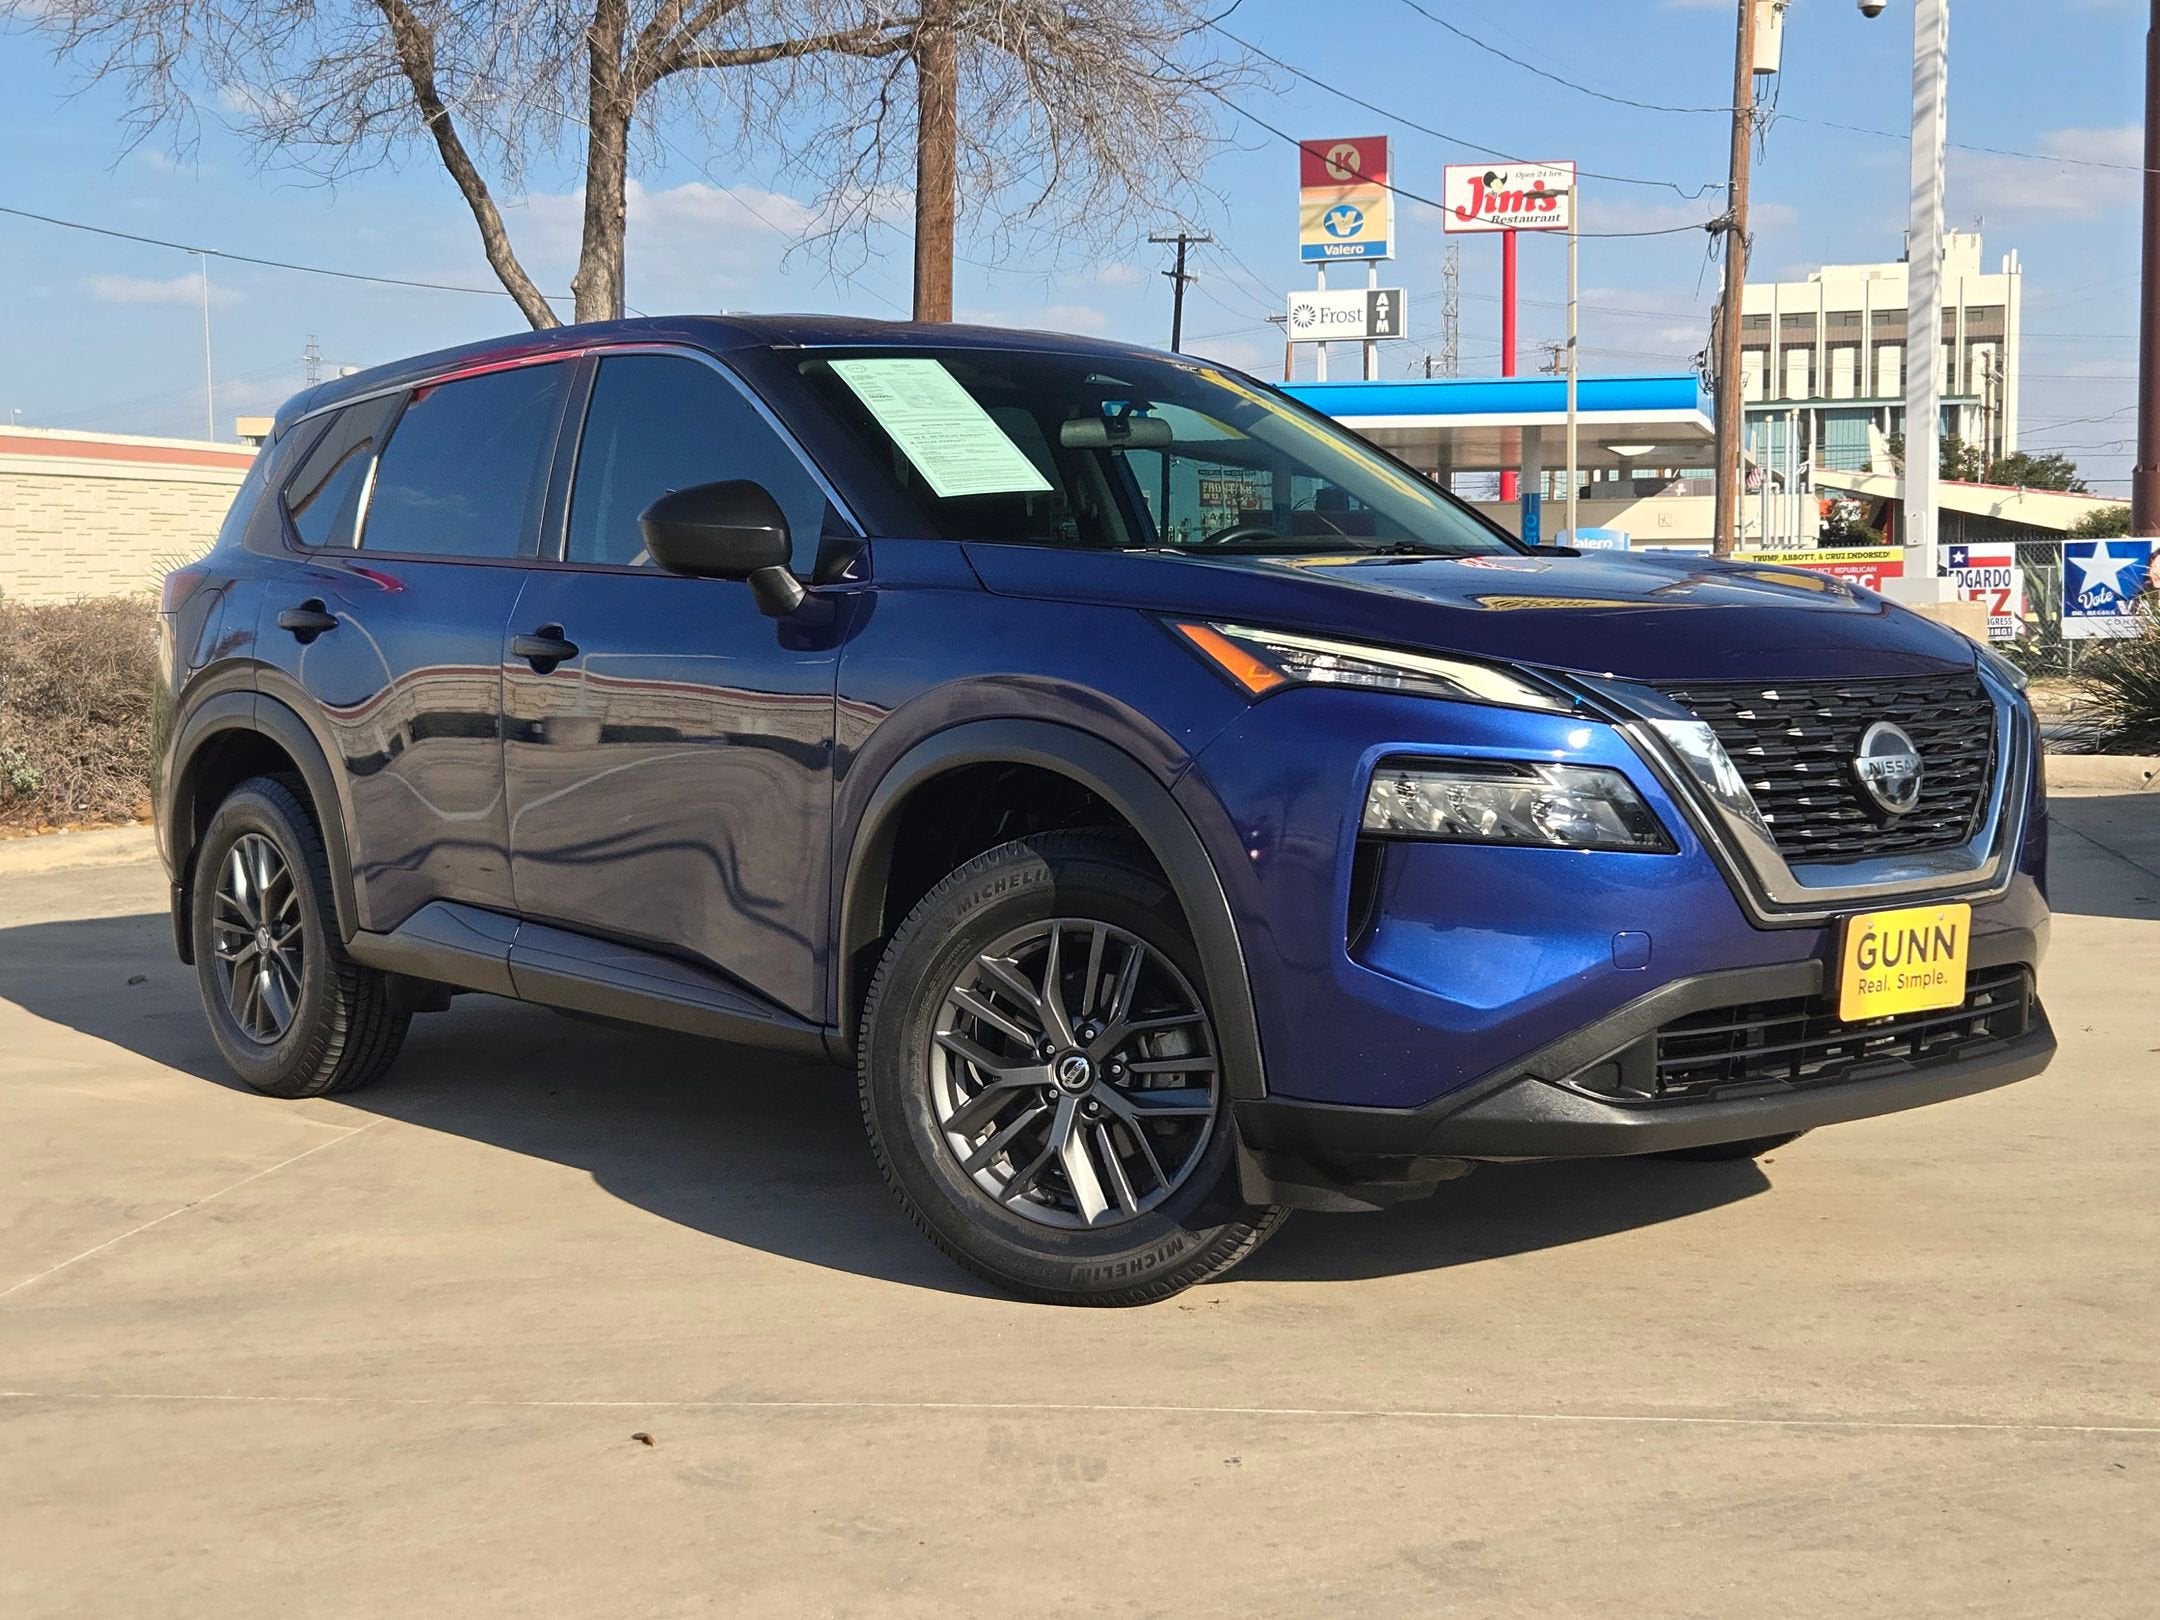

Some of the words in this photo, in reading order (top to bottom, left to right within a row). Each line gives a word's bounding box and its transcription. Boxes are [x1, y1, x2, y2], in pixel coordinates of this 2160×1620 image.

[1334, 151, 1354, 172] K
[1515, 171, 1535, 180] Open
[1491, 213, 1561, 224] Restaurant
[1324, 245, 1365, 255] Valero
[1319, 306, 1364, 324] Frost
[1375, 292, 1390, 334] ATM
[1575, 538, 1613, 549] alero
[1752, 554, 1781, 563] TRUMP,
[1782, 553, 1817, 561] ABBOTT,
[1825, 552, 1846, 560] CRUZ
[1834, 566, 1877, 574] REPUBLICAN
[2078, 587, 2114, 609] Vote
[1857, 923, 1957, 971] GUNN
[1858, 974, 1891, 996] Real.
[1897, 968, 1948, 990] Simple.
[1076, 1236, 1185, 1284] MICHELIN
